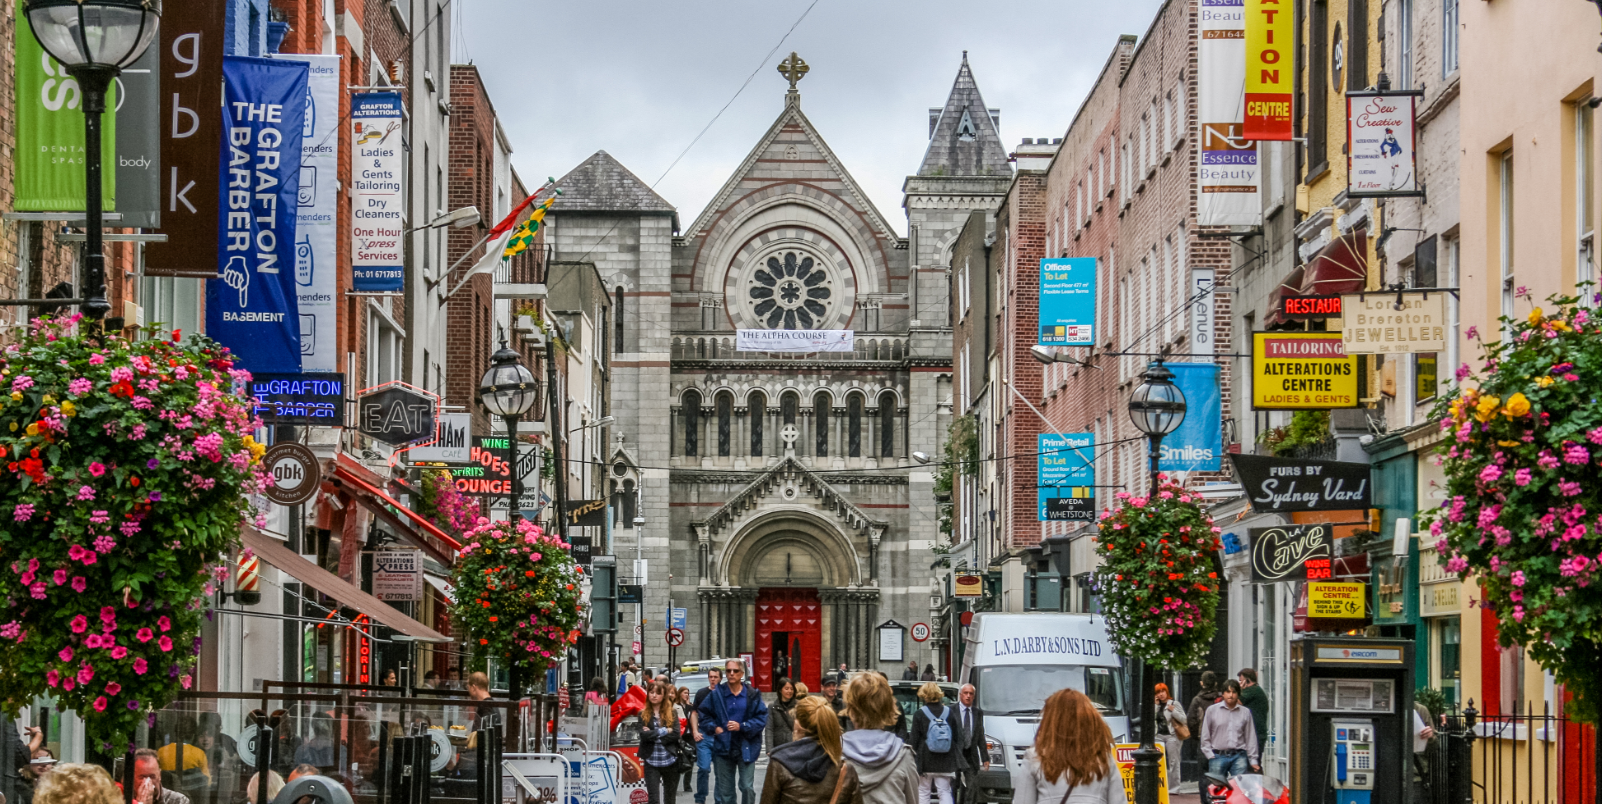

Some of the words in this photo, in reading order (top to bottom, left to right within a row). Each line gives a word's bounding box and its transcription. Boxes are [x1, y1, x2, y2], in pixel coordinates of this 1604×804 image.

[1203, 10, 1243, 20] Beau
[1247, 102, 1290, 116] CENTRE
[1365, 97, 1397, 115] Sew
[232, 102, 283, 123] THE
[1356, 113, 1403, 128] Creative
[303, 145, 332, 153] enders
[361, 148, 394, 156] Ladies
[120, 155, 151, 169] body
[374, 159, 382, 168] &
[1202, 152, 1256, 164] Essence
[362, 170, 393, 178] Gents
[1200, 168, 1255, 180] Beauty
[226, 126, 251, 252] BARBER
[354, 180, 400, 192] Tailoring
[255, 127, 282, 274] GRAFTON
[368, 199, 387, 209] Dry
[355, 210, 400, 218] Cleaners
[354, 228, 374, 236] One
[377, 228, 401, 236] Hour
[358, 239, 397, 250] Xpress
[358, 251, 398, 260] Services
[1285, 297, 1341, 314] RESTAUR
[1365, 299, 1422, 310] Loran
[223, 312, 285, 322] BASEMENT
[1357, 314, 1432, 325] Brereton
[1344, 327, 1444, 344] JEWELLER
[1271, 342, 1342, 355] TAILORING
[1264, 363, 1352, 376] ALTERATIONS
[270, 380, 341, 396] GRAFTON
[1282, 379, 1332, 391] CENTRE
[1264, 395, 1300, 403] LADIES
[1304, 395, 1311, 403] &
[1315, 395, 1351, 403] GENTS
[364, 400, 429, 434] EAT
[415, 418, 465, 448] HAM
[481, 438, 510, 449] WINE
[1043, 439, 1065, 447] Prime
[266, 448, 291, 464] gourmet
[293, 448, 311, 465] burger
[1159, 445, 1213, 460] Smiles
[274, 464, 302, 482] gbk
[1270, 466, 1301, 476] FURS
[1306, 466, 1323, 476] BY
[455, 478, 511, 494] OUNGE
[1255, 478, 1319, 509] Sydney
[1323, 478, 1366, 500] Vard
[1049, 511, 1093, 519] WHETSTONE
[1253, 526, 1329, 579] Cave
[376, 563, 414, 572] XPRESS
[1304, 559, 1331, 568] WINE
[1306, 568, 1332, 579] BAR
[915, 627, 925, 635] 50
[994, 636, 1079, 656] L.N.DARBY&SONS
[1082, 639, 1101, 657] LTD
[360, 614, 370, 695] AILORIN
